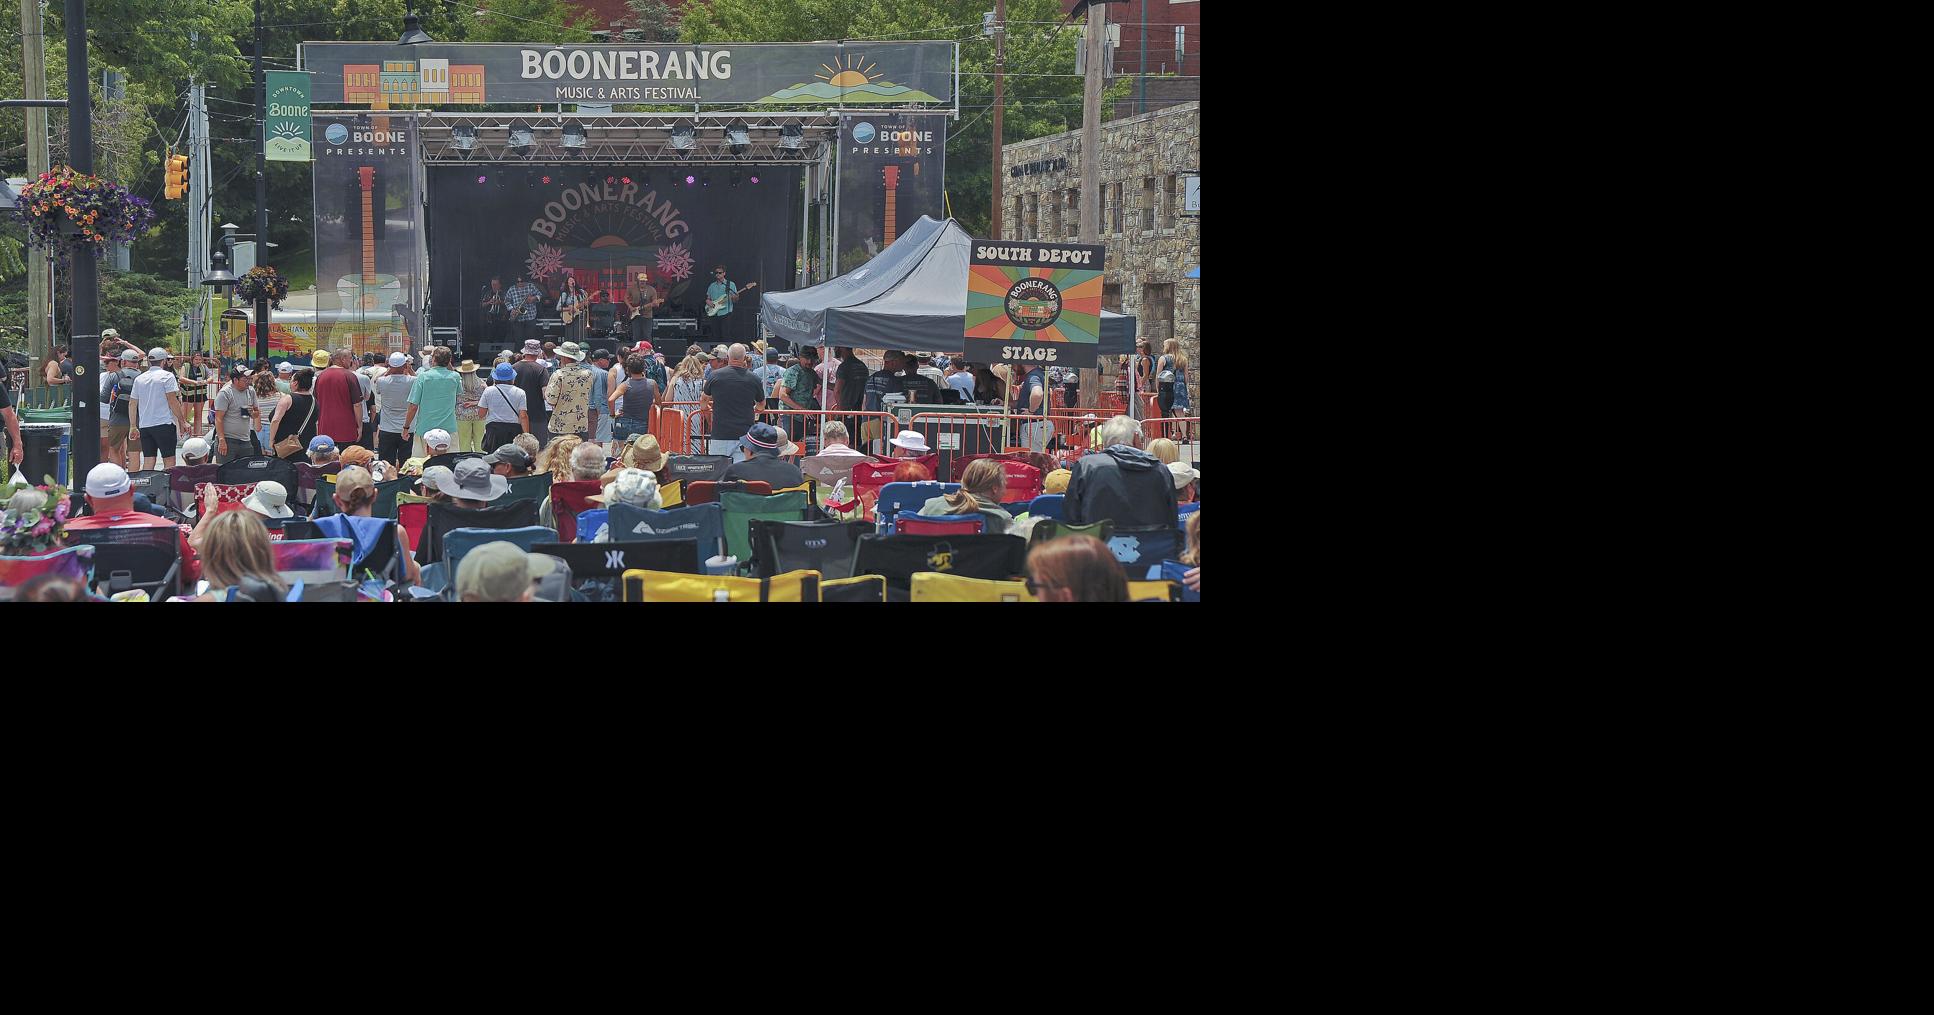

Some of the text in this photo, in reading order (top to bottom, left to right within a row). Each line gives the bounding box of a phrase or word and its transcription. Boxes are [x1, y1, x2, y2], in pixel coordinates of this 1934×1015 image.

[520, 50, 731, 80] BOONERANG
[272, 86, 304, 98] DOWNTOWN
[556, 88, 701, 100] MUSIC & ARTS FESTIVAL
[269, 102, 308, 116] Boone
[353, 132, 406, 142] BOONE
[880, 130, 932, 142] BOONE
[531, 179, 688, 238] BOONERANG
[555, 213, 580, 242] MUSIC
[594, 202, 620, 214] ARTS
[624, 206, 662, 241] FESTIVAL
[977, 246, 1092, 264] SOUTH DEPOT
[1011, 280, 1057, 300] BOONERANG
[1002, 346, 1057, 361] STAGE
